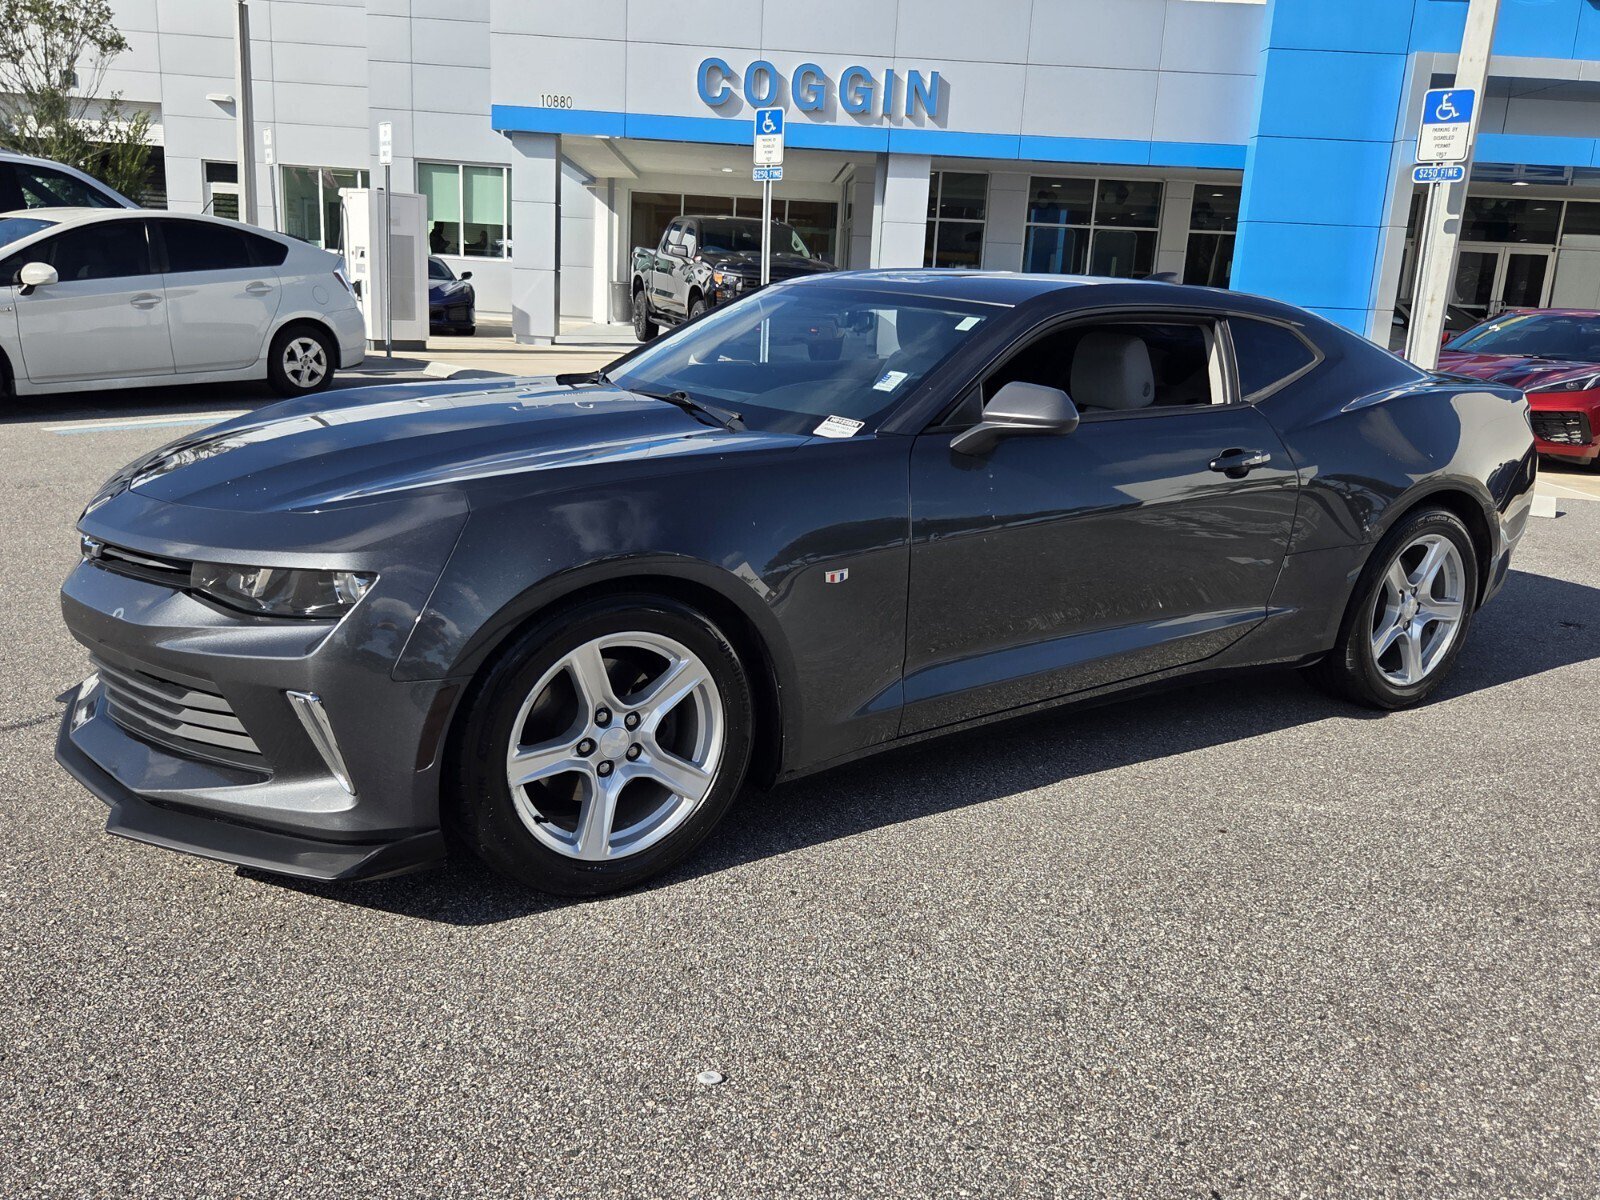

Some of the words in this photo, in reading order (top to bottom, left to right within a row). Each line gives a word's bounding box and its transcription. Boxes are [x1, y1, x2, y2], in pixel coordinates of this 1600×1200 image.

[697, 57, 940, 117] COGGIN
[541, 94, 573, 109] 10880
[1419, 168, 1438, 178] $250
[1440, 168, 1458, 177] FINE
